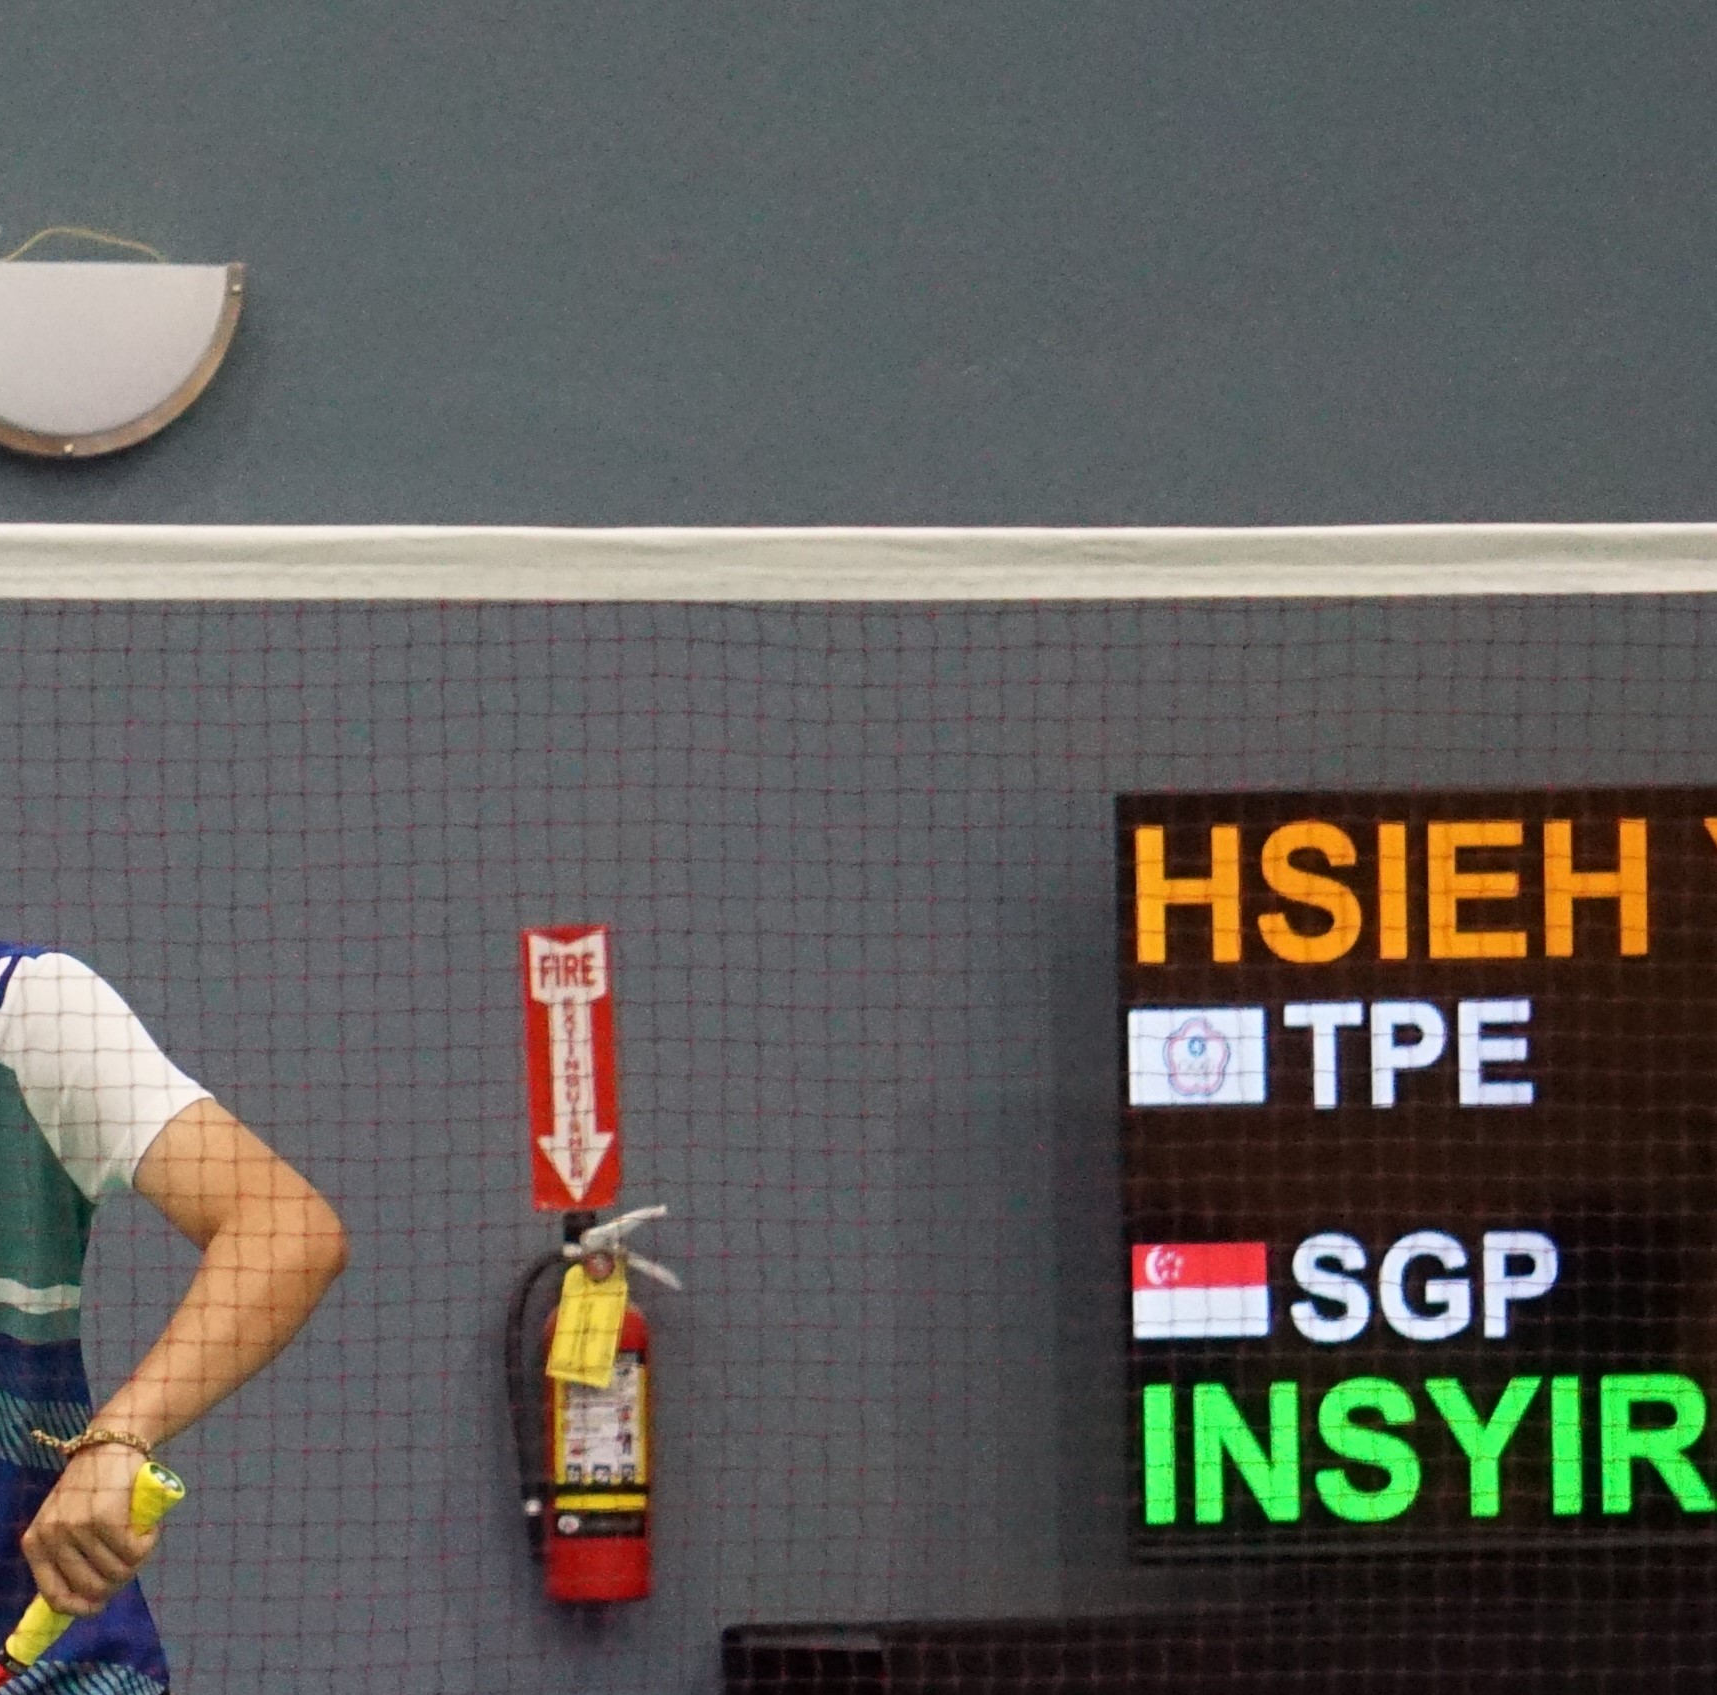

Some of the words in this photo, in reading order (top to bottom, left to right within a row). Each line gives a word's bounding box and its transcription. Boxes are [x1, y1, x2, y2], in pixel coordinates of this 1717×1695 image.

[1134, 817, 1649, 964] HSIEH
[540, 953, 595, 988] FIRE
[1283, 999, 1534, 1109] TPE
[1290, 1231, 1558, 1343] SGP
[1143, 1373, 1717, 1525] INSYIR
